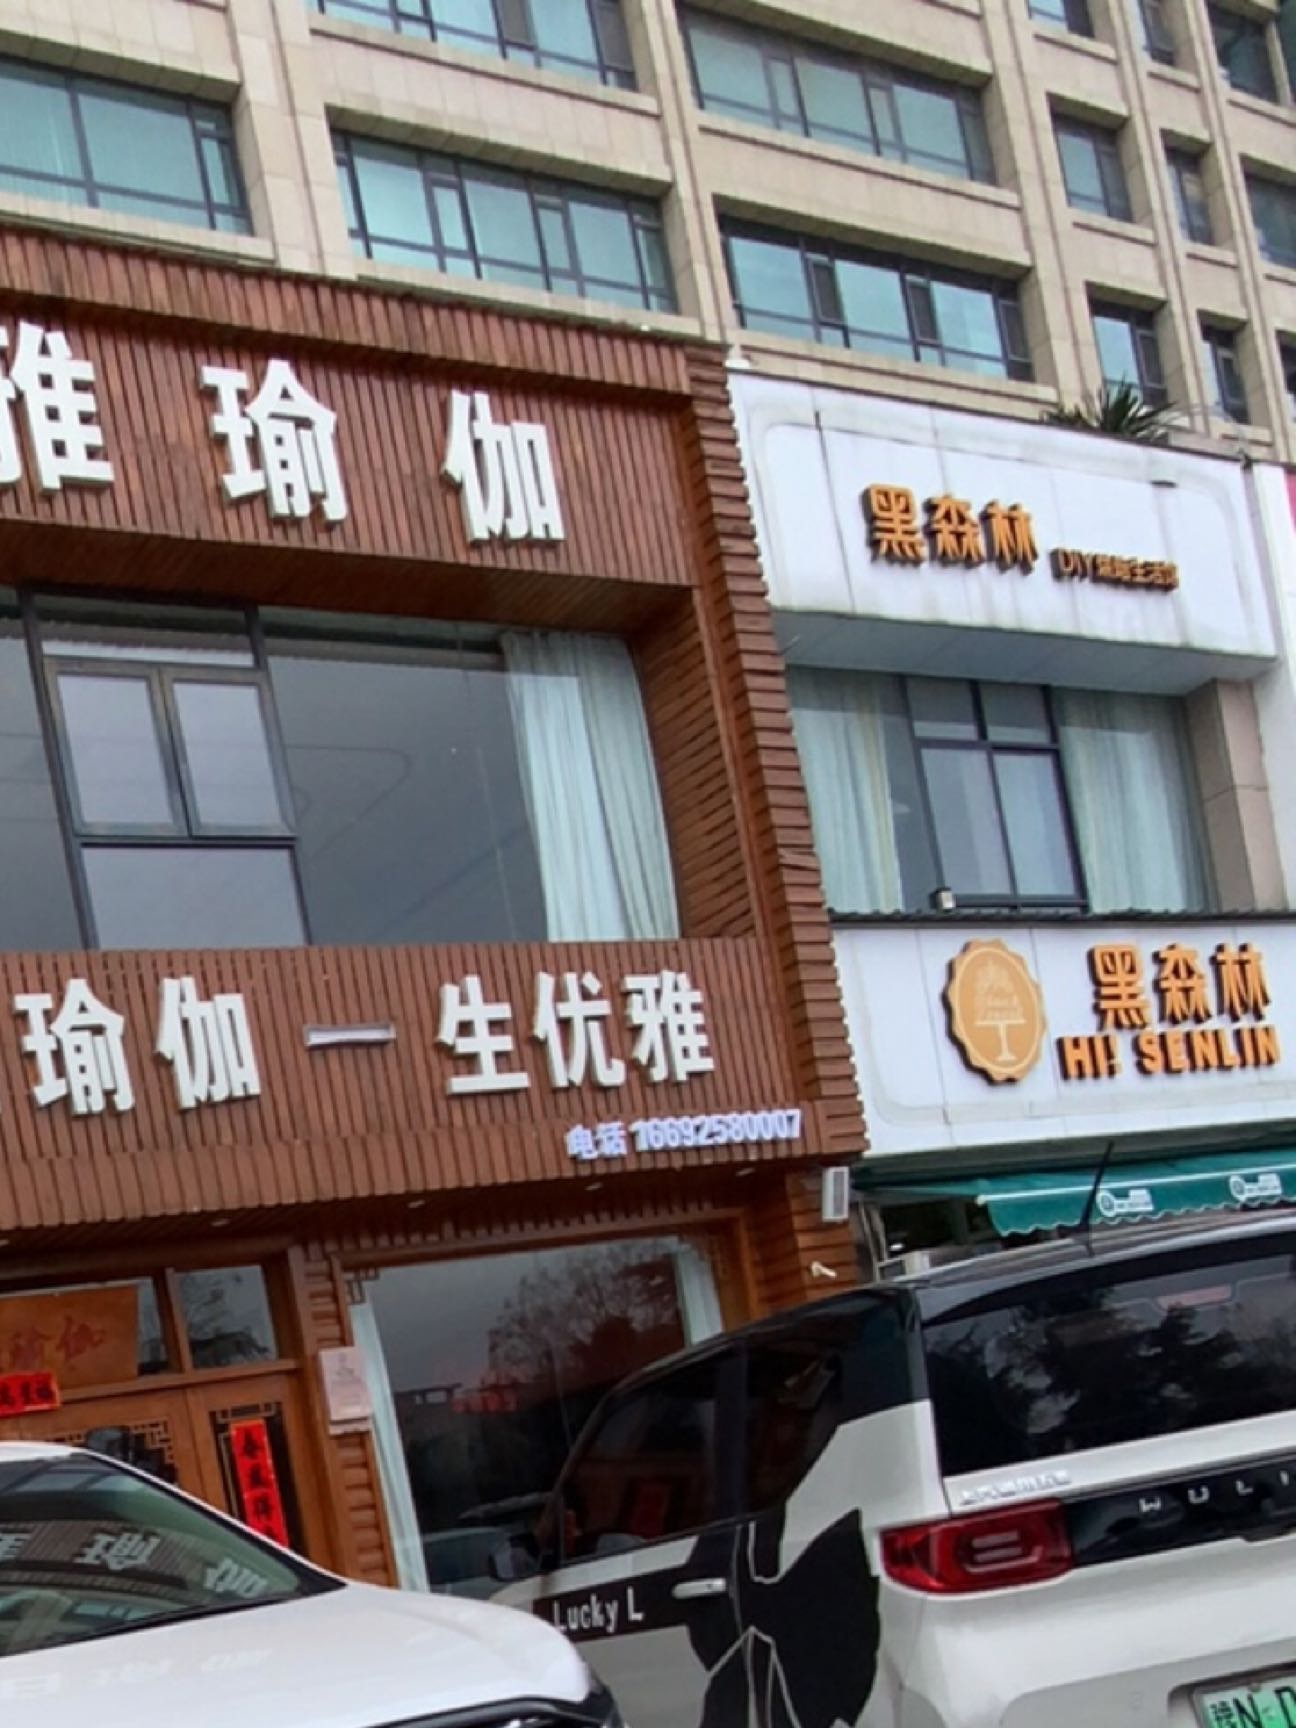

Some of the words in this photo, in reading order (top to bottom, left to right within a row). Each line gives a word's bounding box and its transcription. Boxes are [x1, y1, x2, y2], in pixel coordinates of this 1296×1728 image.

[861, 483, 1038, 575] 黑森林
[1088, 943, 1270, 1030] 黑森林
[1057, 1034, 1122, 1080] HI!
[1134, 1025, 1281, 1076] SENLIN
[566, 1123, 628, 1160] 电话
[551, 1592, 619, 1634] Lucky
[626, 1585, 644, 1621] L
